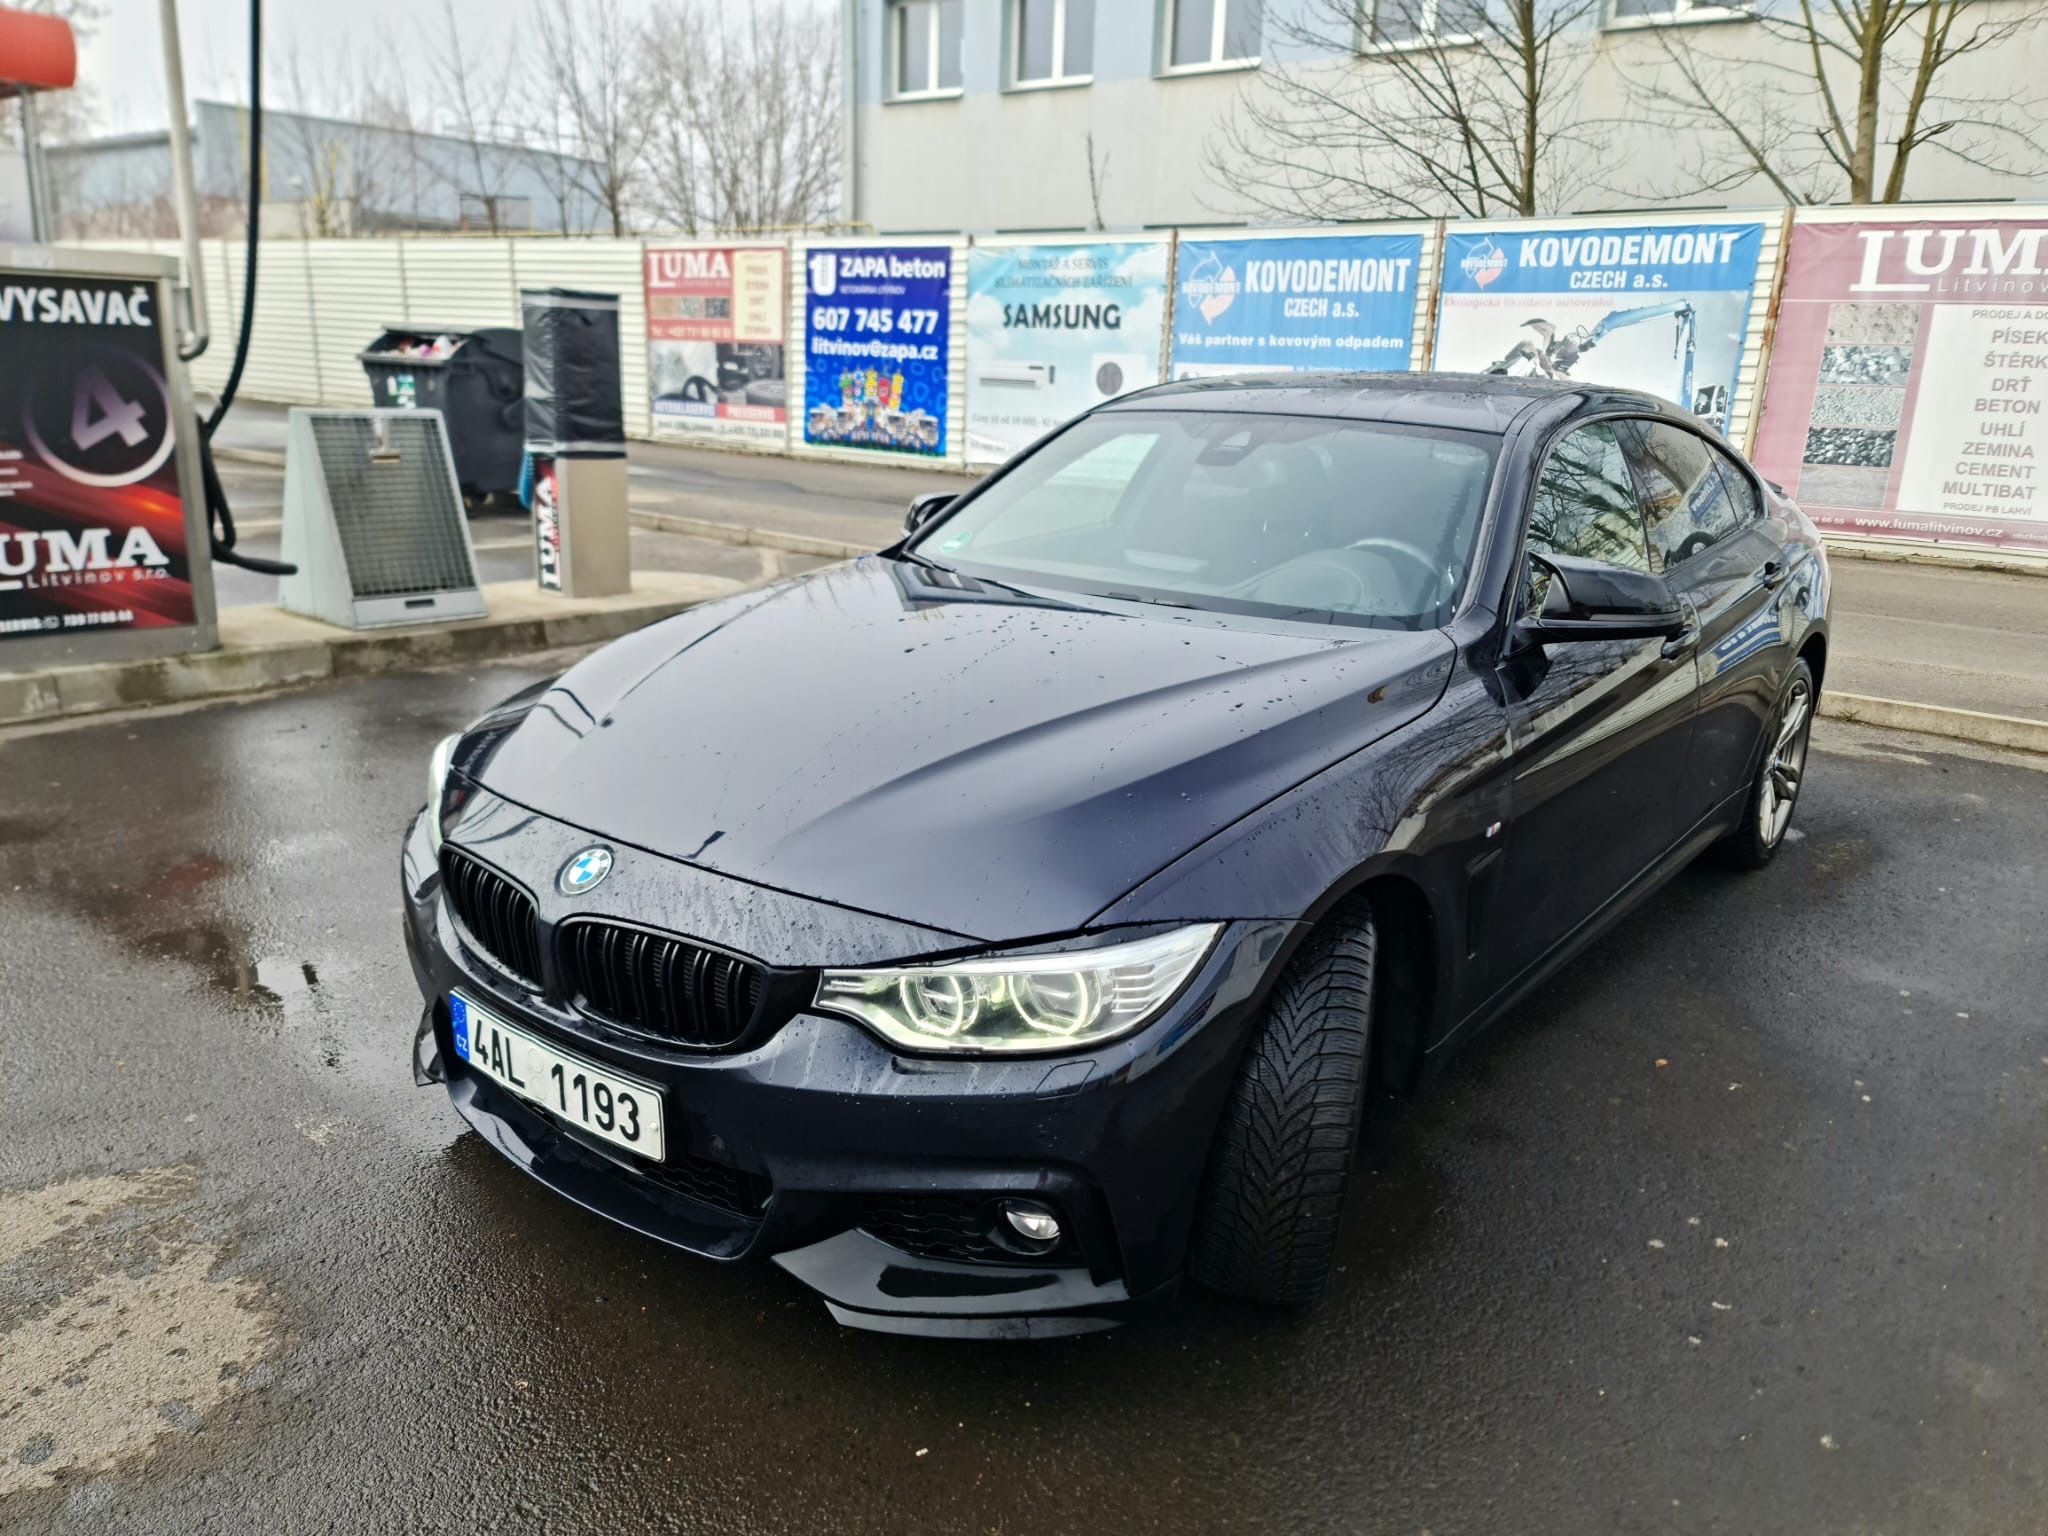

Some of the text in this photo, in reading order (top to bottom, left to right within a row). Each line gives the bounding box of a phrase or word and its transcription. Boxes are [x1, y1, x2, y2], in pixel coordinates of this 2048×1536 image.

[1519, 232, 1741, 268] KOVODEMONT
[1849, 228, 2048, 292] LUM
[648, 252, 731, 288] LUMA
[840, 254, 946, 279] ZAPA beton
[1072, 258, 1109, 269] SERVIS
[1245, 258, 1411, 293] KOVODEMONT
[1570, 271, 1668, 289] CZECH a.s.
[0, 285, 152, 327] VYSAVAČ
[1284, 298, 1360, 318] CZECH a.s.
[1972, 309, 2021, 320] PRODEJ
[2023, 310, 2032, 320] A
[813, 306, 940, 335] 607 745 477
[1003, 303, 1121, 330] SAMSUNG
[1179, 333, 1404, 350] Váš partner s kovovým odpadem
[1992, 326, 2048, 345] PÍSEK
[811, 336, 939, 363] litvinov@zapa.cz
[1984, 350, 2048, 369] ŠTĚRK
[1992, 376, 2032, 393] DRŤ
[70, 363, 149, 452] 4
[1974, 397, 2041, 415] BETON
[1980, 420, 2027, 437] UHLÍ
[1961, 441, 2035, 459] ZEMINA
[1955, 461, 2037, 479] CEMENT
[1942, 480, 2038, 500] MULTIBAT
[1943, 502, 1982, 512] PRODEJ
[1985, 505, 1999, 514] PB
[536, 475, 562, 588] LUMA
[1855, 516, 2004, 538] www.lumalitvinov.cz
[0, 526, 170, 590] UMA
[132, 567, 171, 582] s.r.o.
[456, 1034, 468, 1052] CZ
[475, 1019, 641, 1142] 4AL 1193
